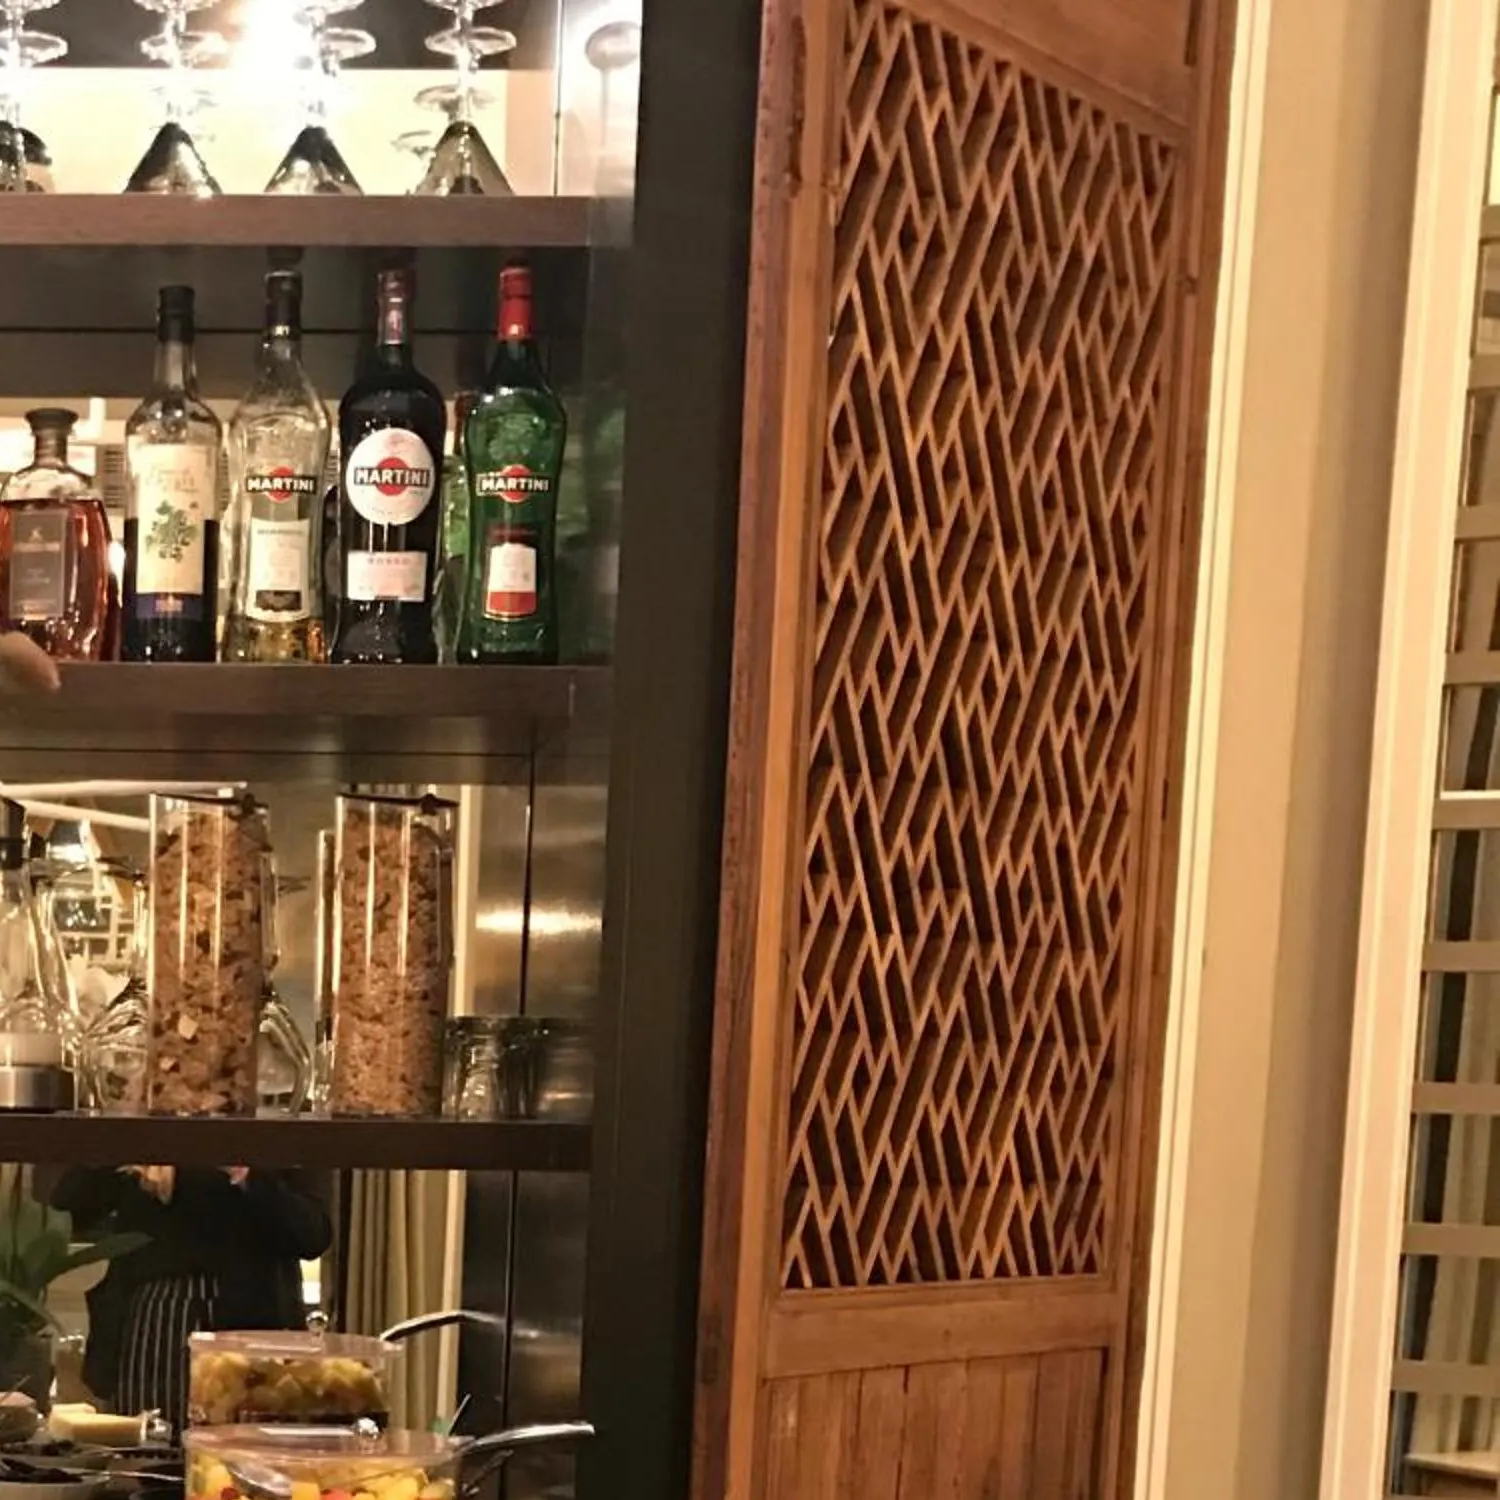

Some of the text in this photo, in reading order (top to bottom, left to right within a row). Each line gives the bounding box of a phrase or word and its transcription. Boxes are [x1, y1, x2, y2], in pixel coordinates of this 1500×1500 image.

[247, 477, 314, 491] MARTINI
[355, 469, 428, 485] MARTINI
[482, 477, 549, 491] MARTINI
